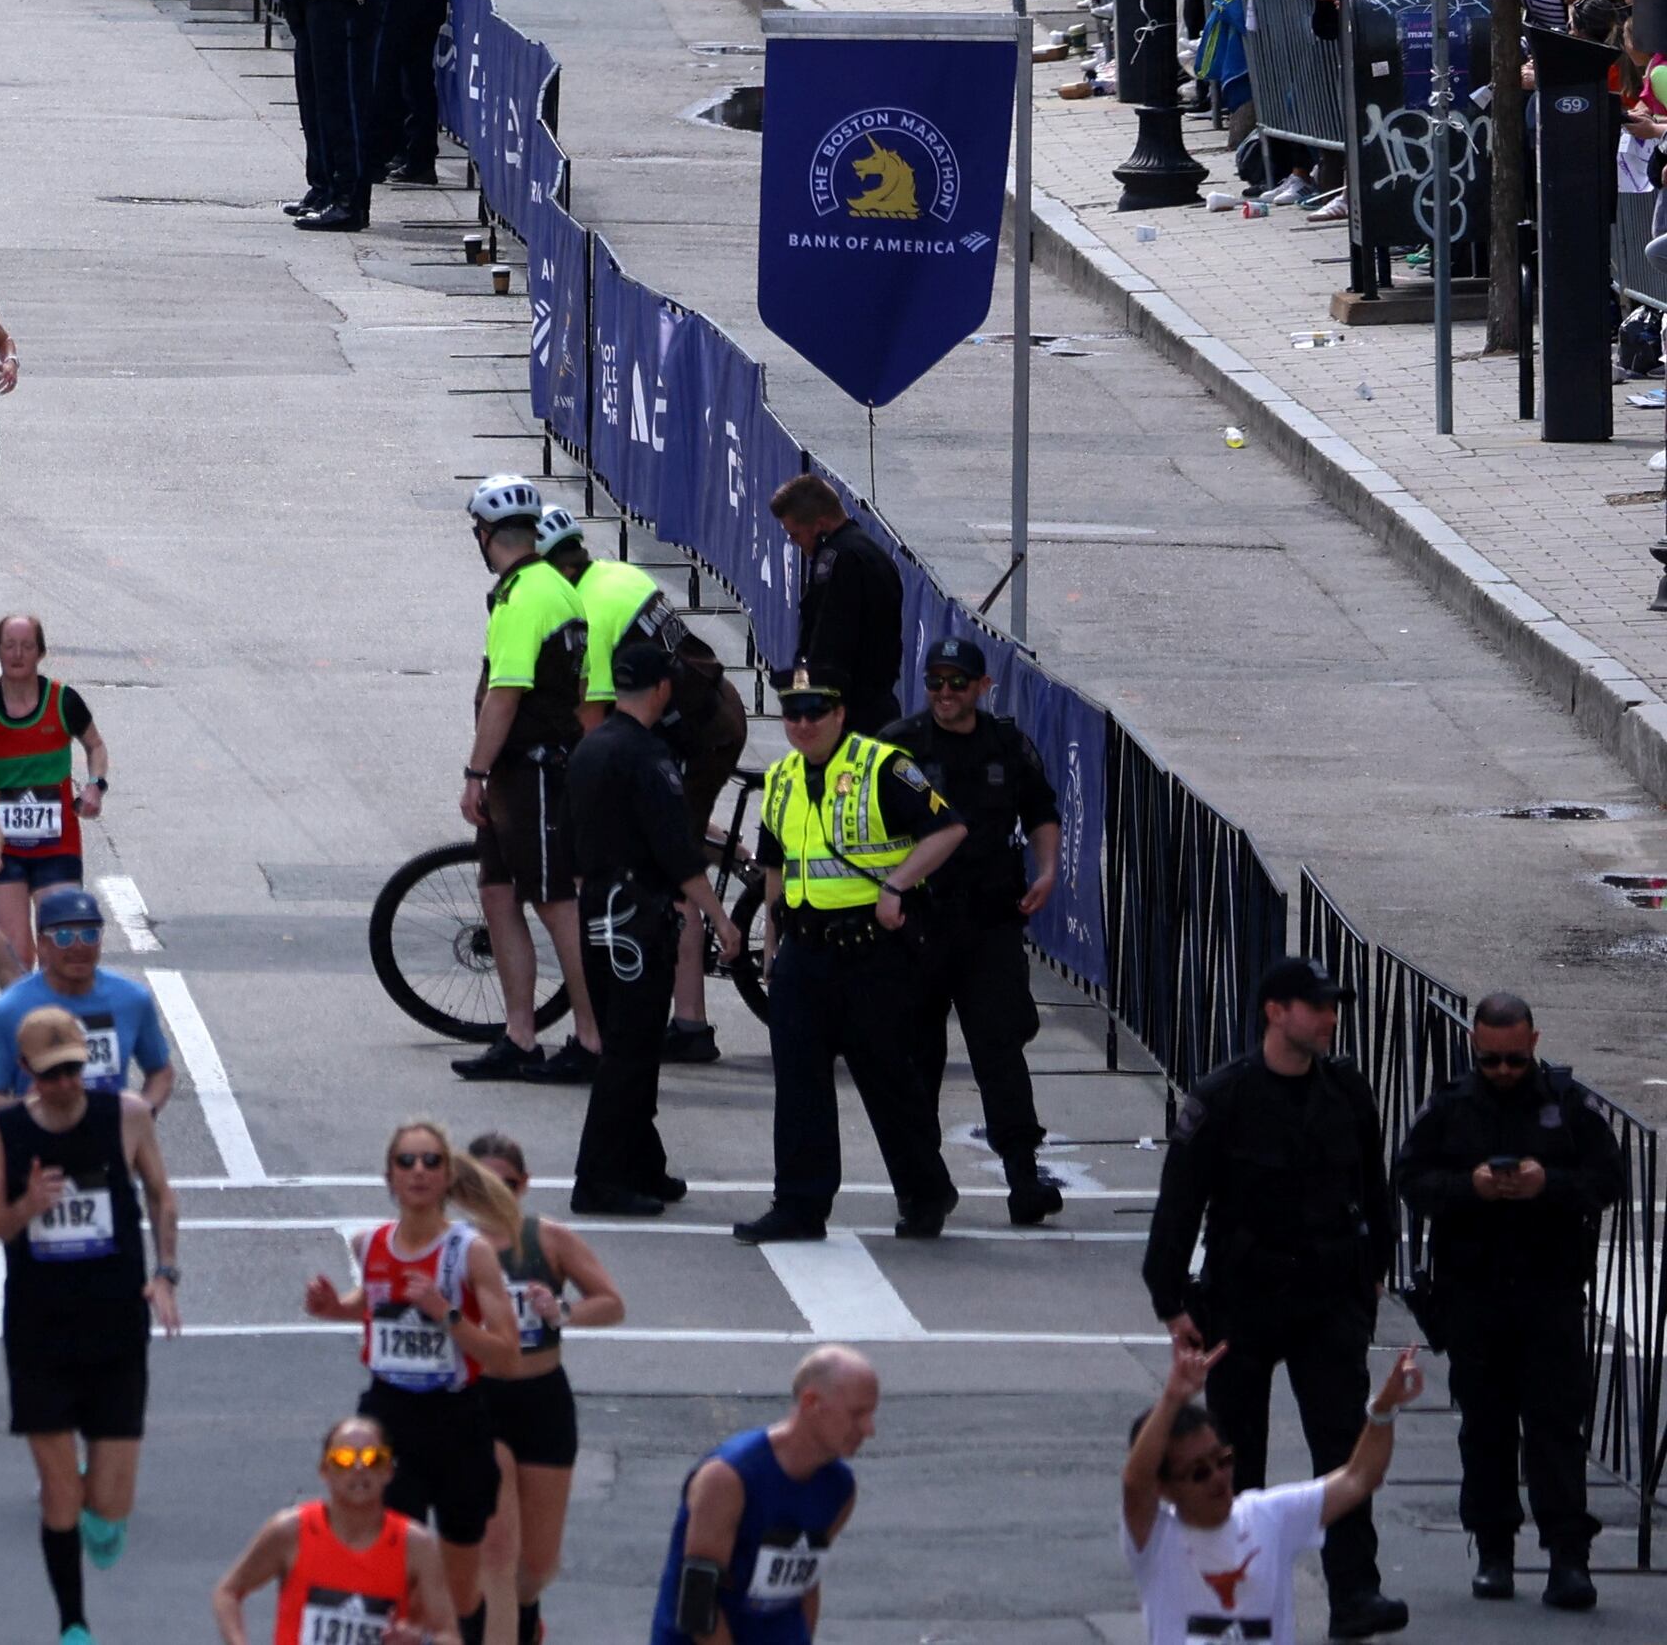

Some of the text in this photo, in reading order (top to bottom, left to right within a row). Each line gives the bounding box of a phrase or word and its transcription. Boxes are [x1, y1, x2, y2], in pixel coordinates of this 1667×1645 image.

[1560, 98, 1584, 112] 59
[814, 113, 955, 210] THE BOSTON MARATHON
[788, 233, 956, 255] BANK OF AMERICA
[3, 808, 53, 829] 13371
